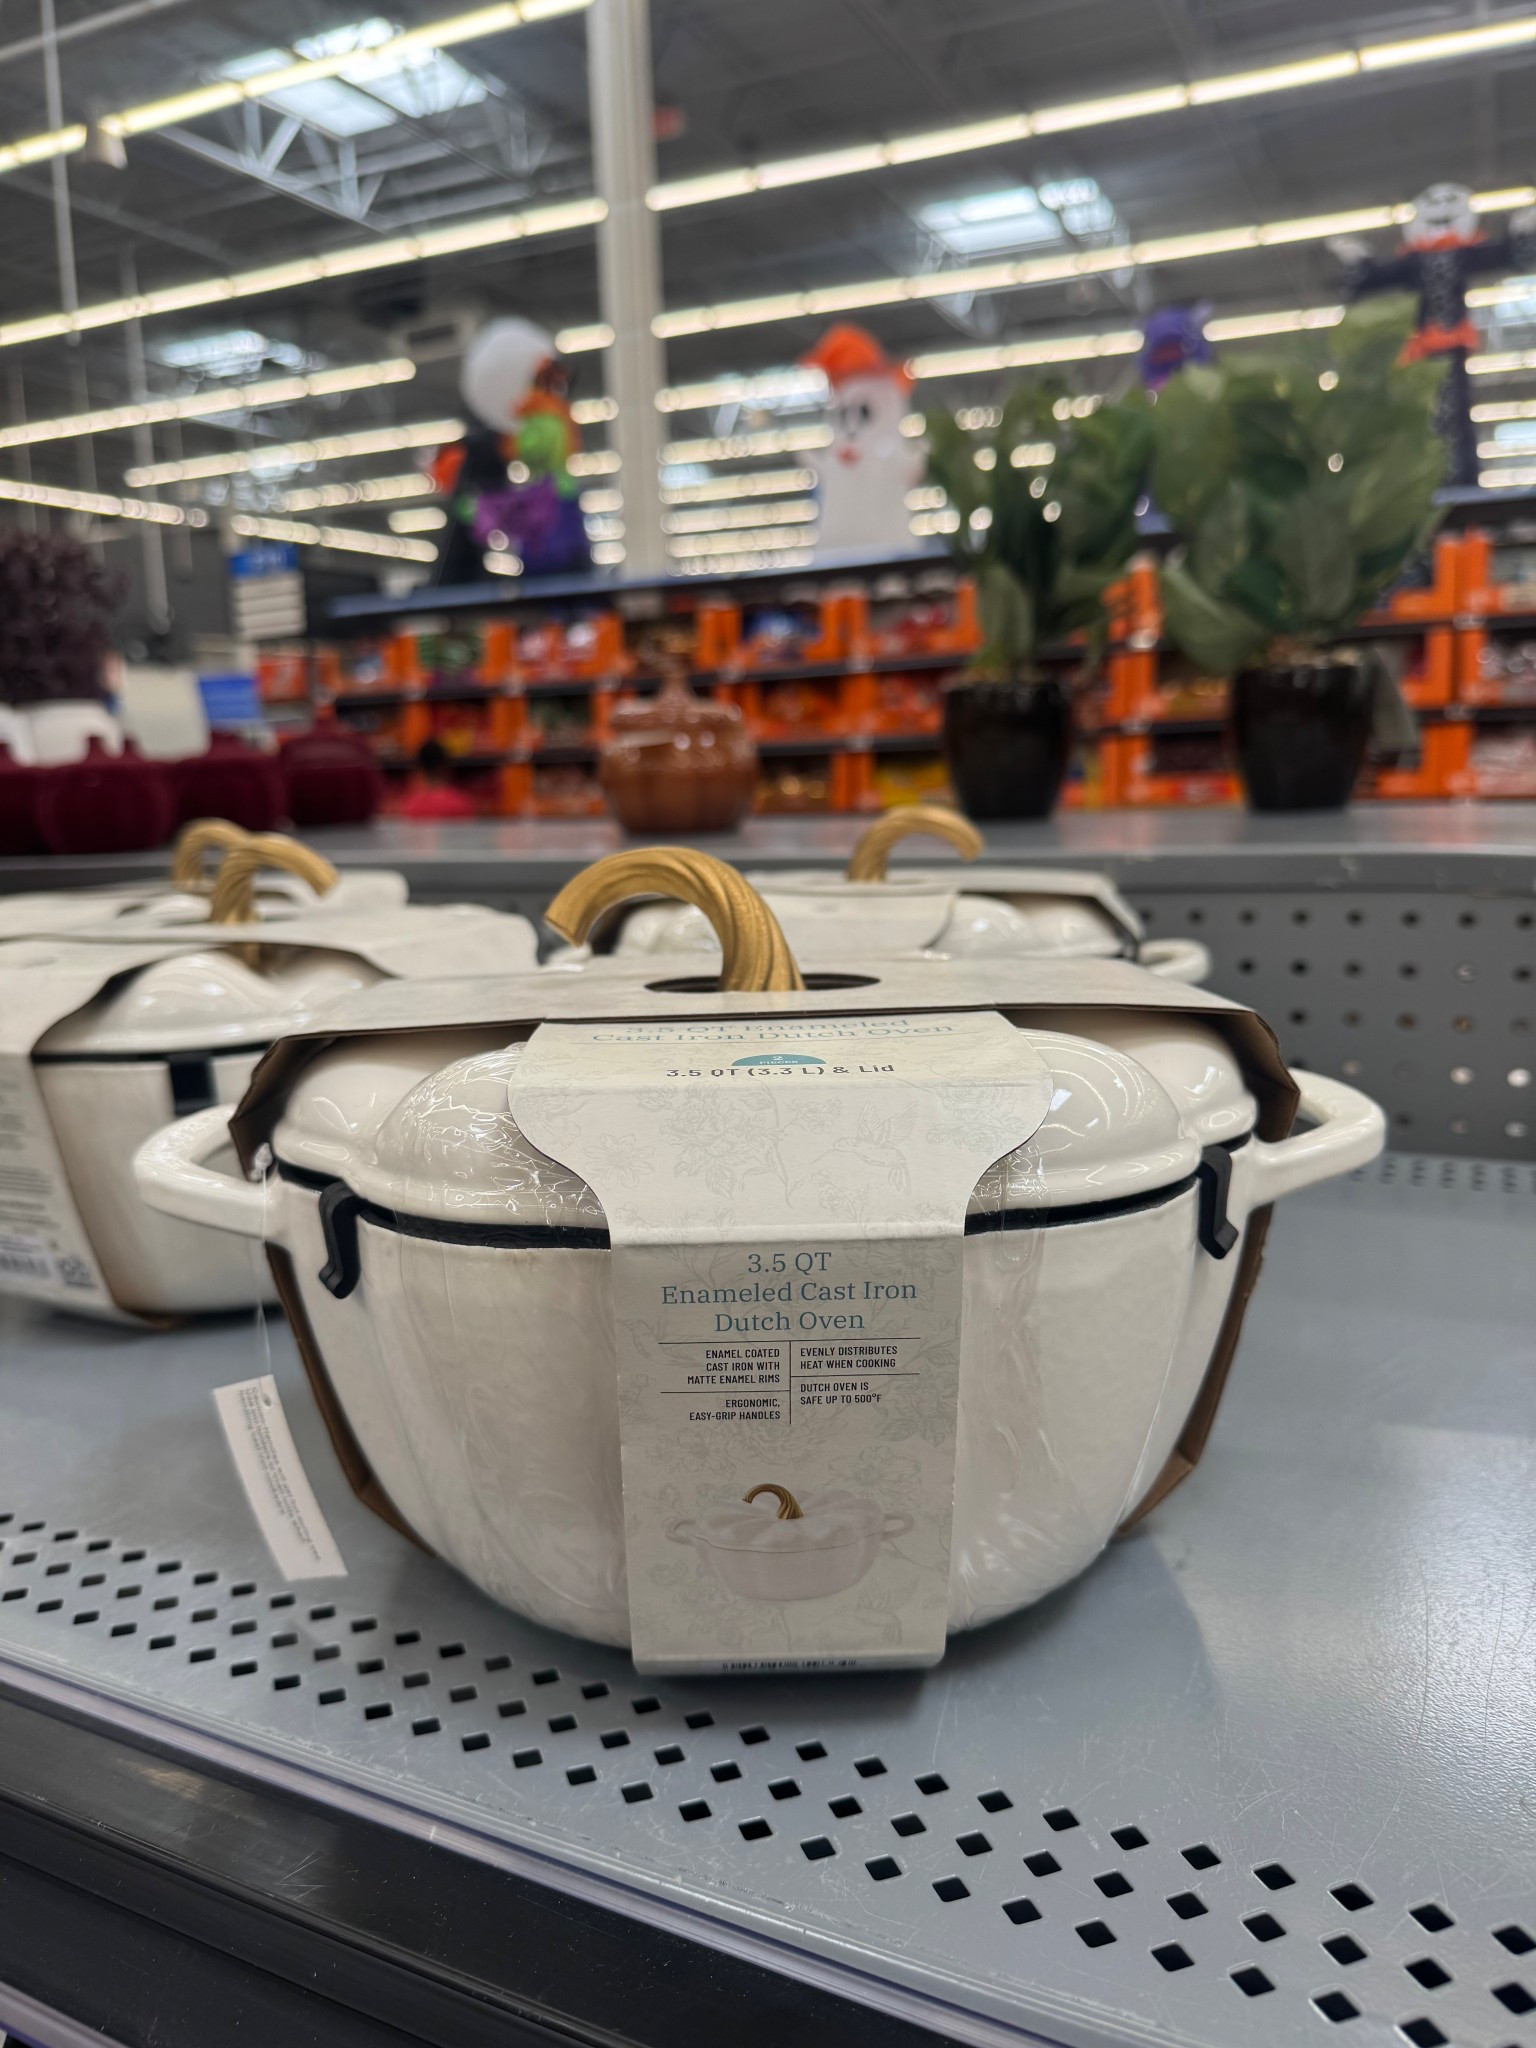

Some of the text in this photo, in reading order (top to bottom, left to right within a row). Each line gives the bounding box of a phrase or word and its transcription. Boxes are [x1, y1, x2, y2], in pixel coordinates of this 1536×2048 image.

[745, 1020, 908, 1031] Enameled
[759, 1030, 855, 1039] Dutch
[869, 1026, 953, 1035] Oven
[666, 1069, 701, 1077] 3.5
[747, 1068, 792, 1076] (3.3
[748, 1252, 831, 1274] 3.5 QT
[662, 1281, 917, 1305] Enameled Cast Iron
[715, 1312, 864, 1332] Dutch Oven
[706, 1349, 779, 1358] ENAMEL COATED
[801, 1346, 897, 1356] EVENLY DISTRIBUTES
[706, 1362, 779, 1371] CAST IRON WITH
[801, 1359, 895, 1369] HEAT WHEN COOKING
[688, 1374, 779, 1384] MATTE ENAMEL RIMS
[801, 1382, 869, 1392] DUTCH OVEN IS
[801, 1393, 881, 1404] SAFE UP TO 500°F
[725, 1399, 780, 1409] ERGONOMIC,
[689, 1411, 780, 1421] EASY-GRIP HANDLES
